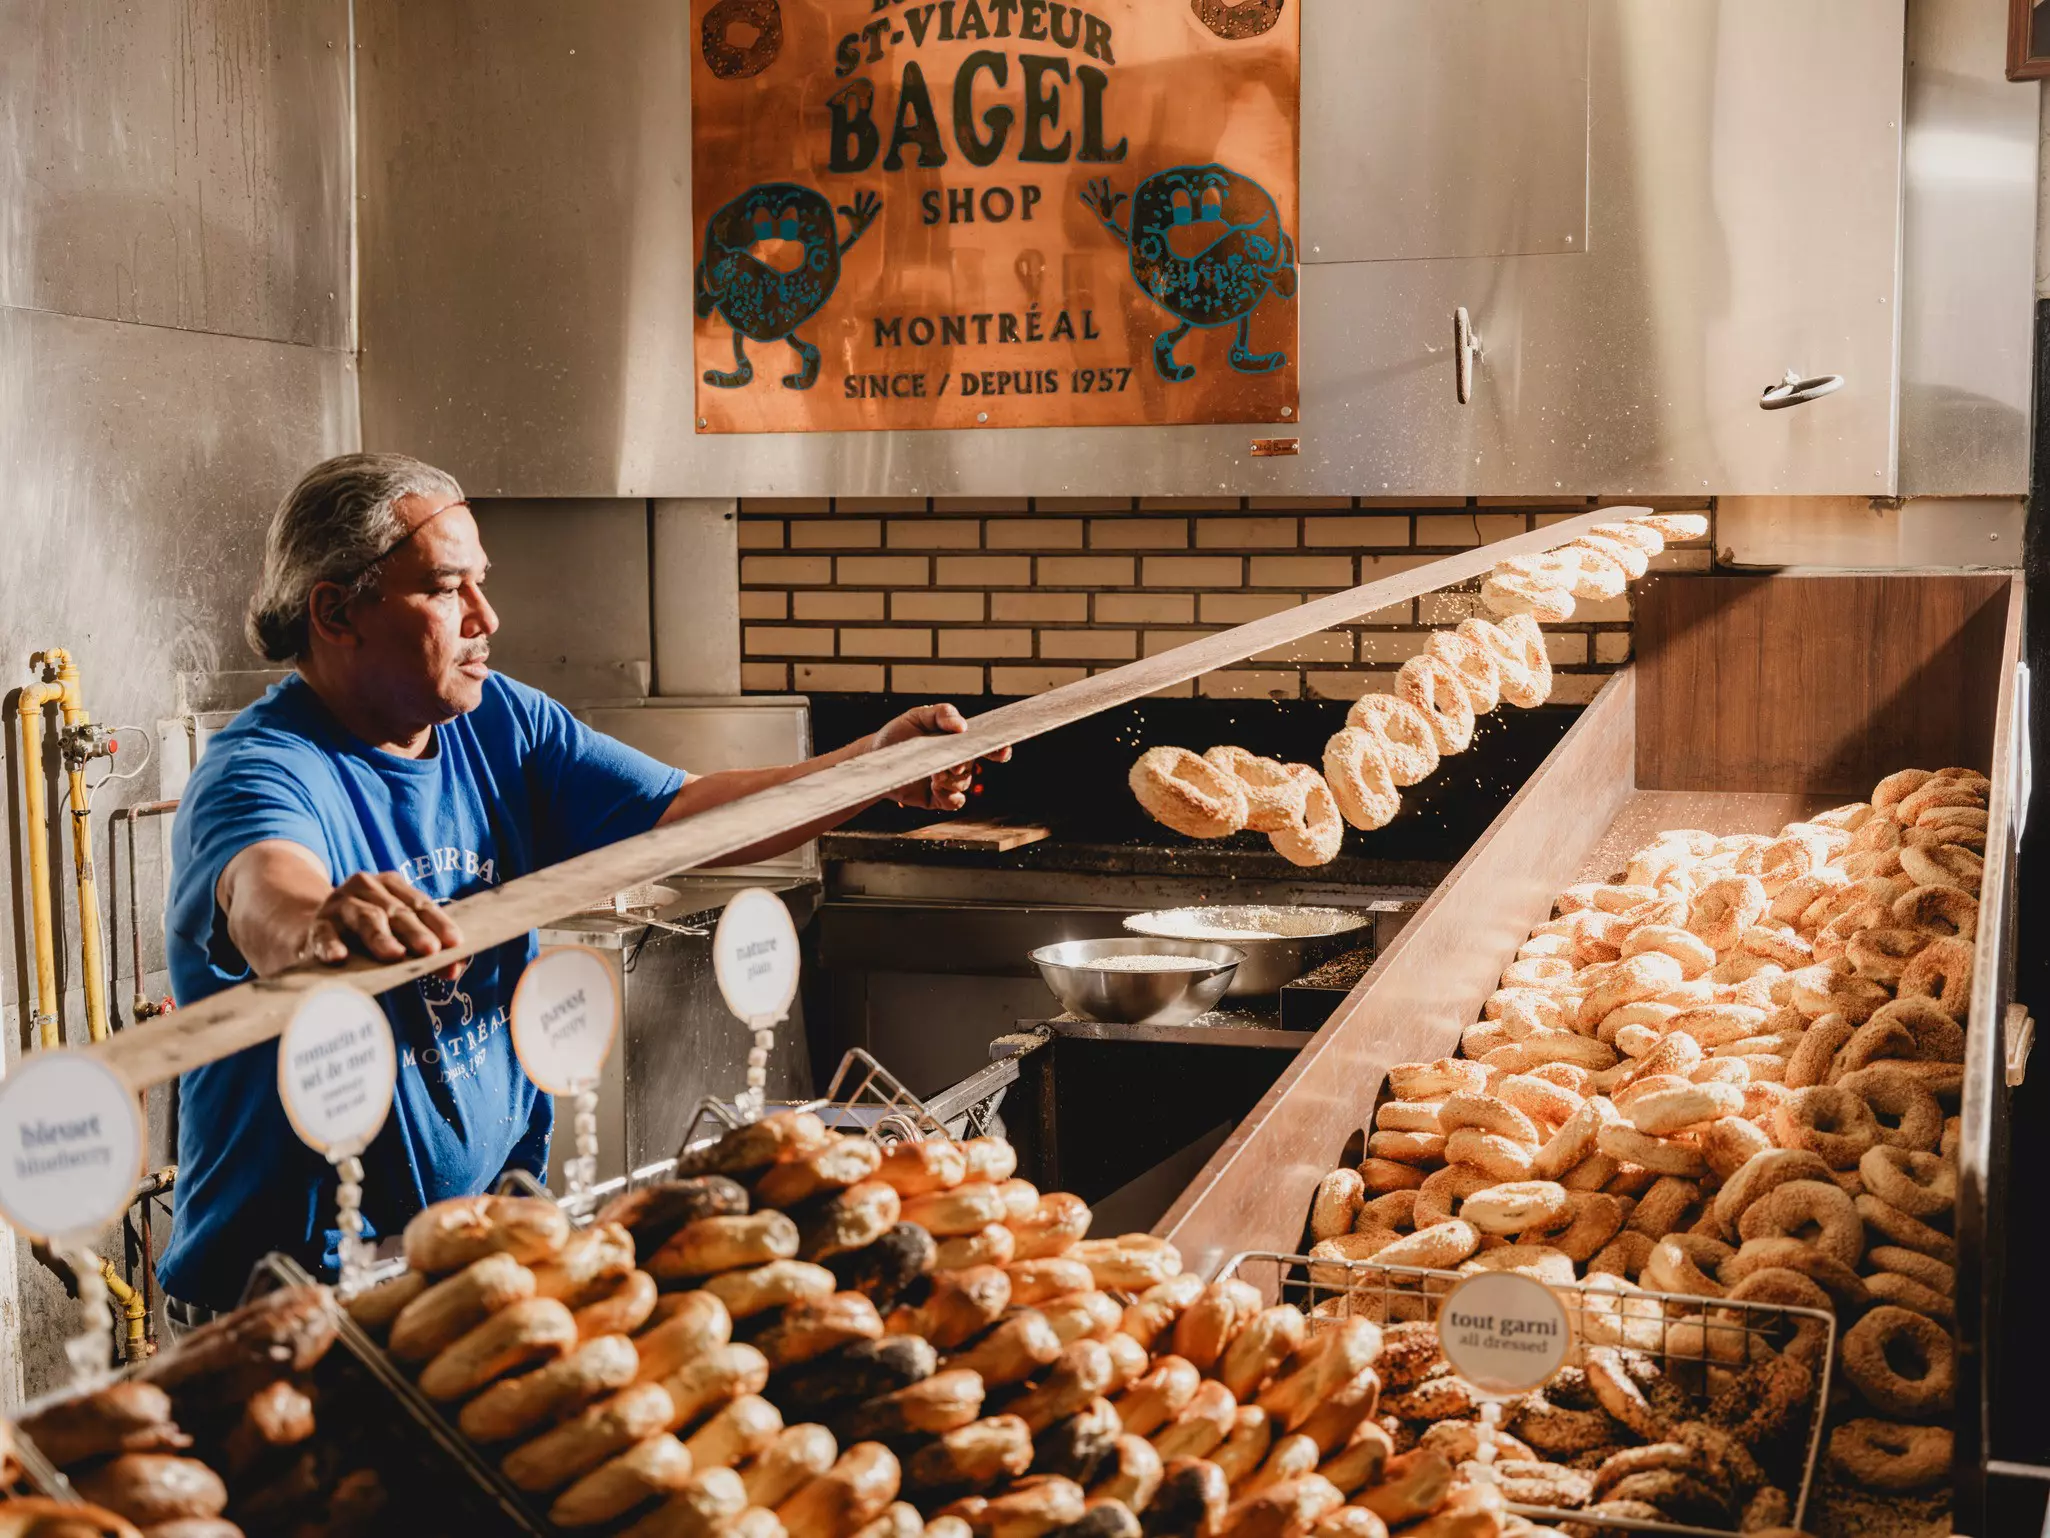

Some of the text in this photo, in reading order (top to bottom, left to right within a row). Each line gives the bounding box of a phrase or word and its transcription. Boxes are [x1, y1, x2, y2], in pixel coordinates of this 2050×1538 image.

[834, 0, 1116, 78] ST-VIATEUR
[826, 50, 1128, 174] BAGEL
[921, 184, 1042, 225] SHOP
[873, 303, 1100, 347] MONTRÉAL
[843, 367, 1133, 399] SINCE / DEPUIS 1957
[1451, 1311, 1558, 1337] tout garni
[1459, 1332, 1549, 1354] all dressed
